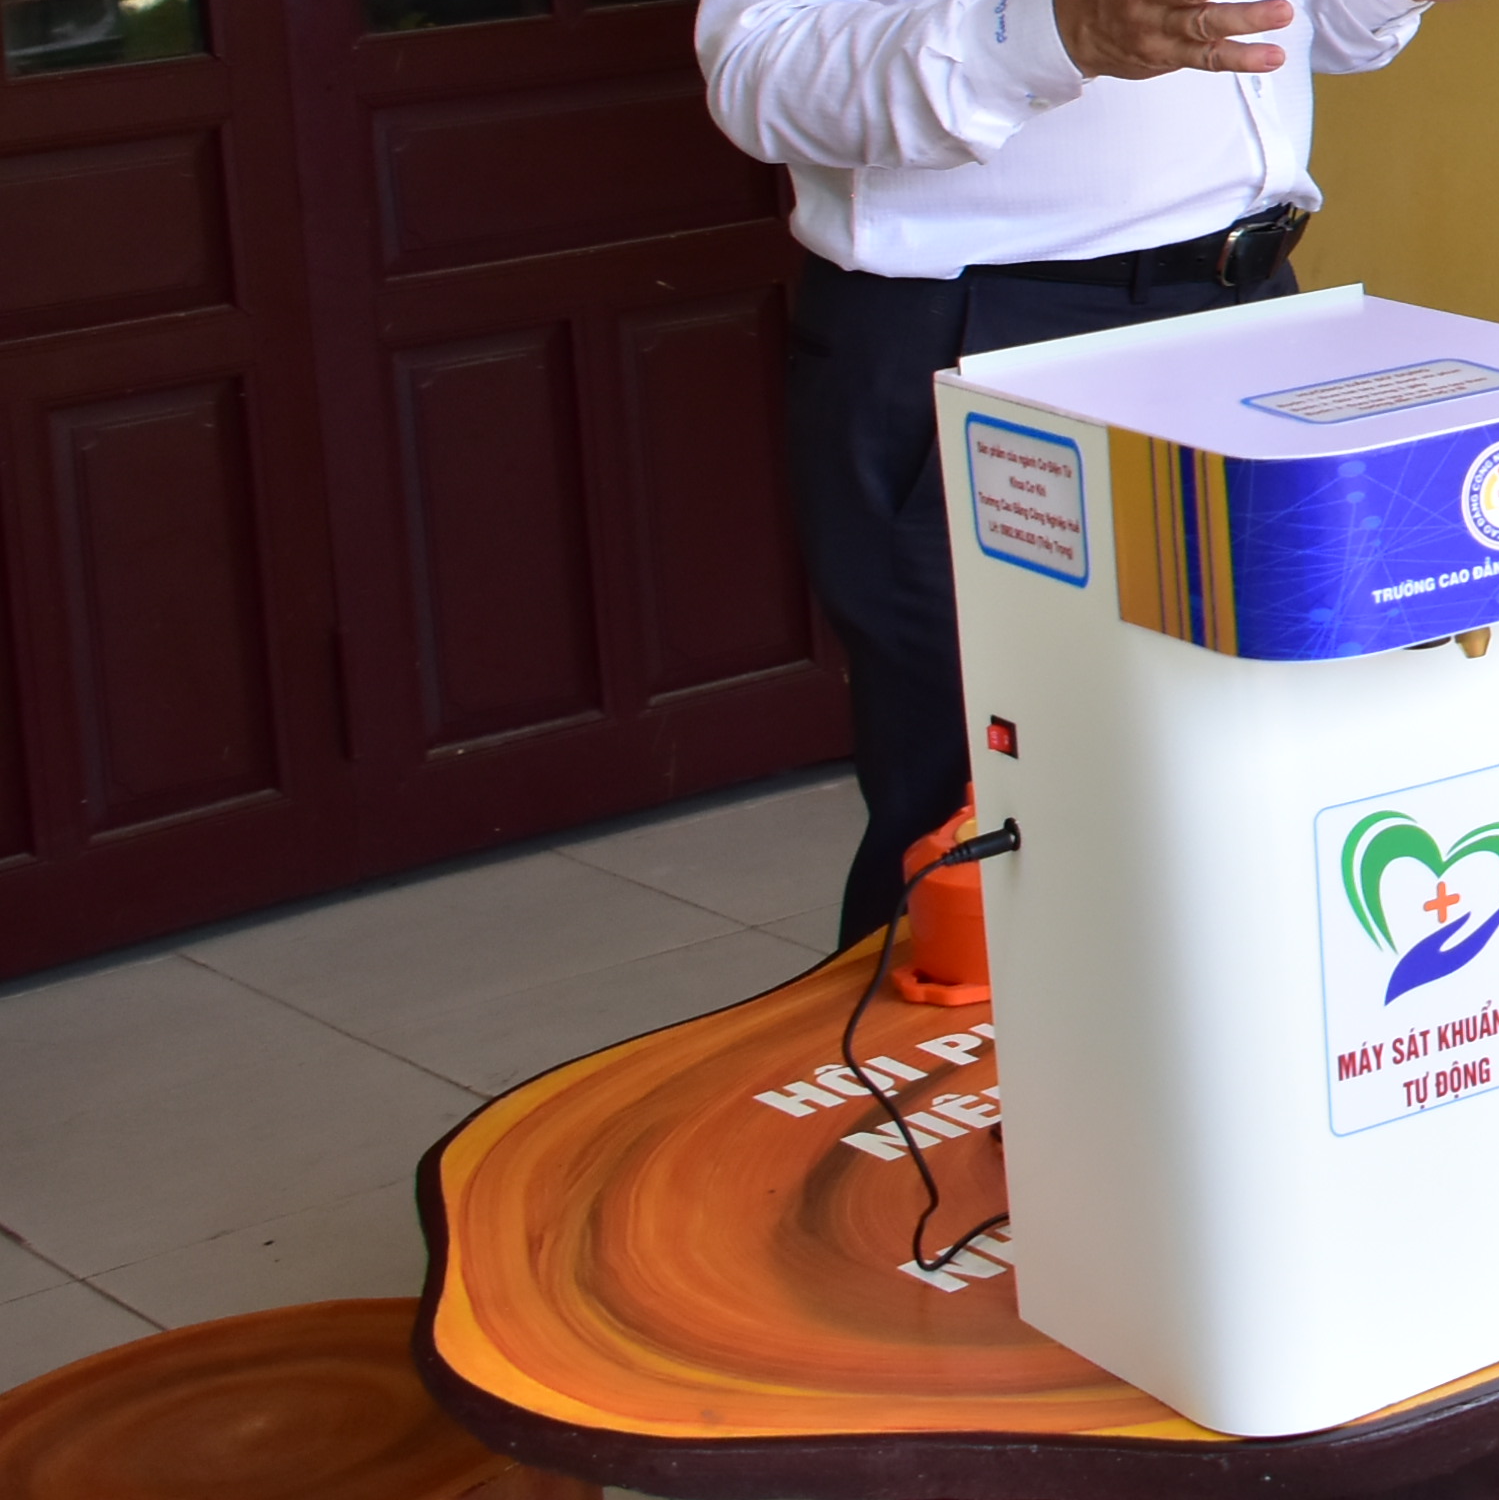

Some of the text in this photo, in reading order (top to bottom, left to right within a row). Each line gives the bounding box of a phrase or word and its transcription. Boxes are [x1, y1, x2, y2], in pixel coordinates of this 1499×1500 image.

[1372, 579, 1436, 604] TRƯỜNG
[1439, 569, 1470, 588] CAO
[1337, 1041, 1385, 1082] MÁY
[1391, 1027, 1430, 1066] SÁT
[753, 1056, 929, 1118] HỘI
[1403, 1056, 1491, 1110] TỰ ĐỘNG
[840, 1085, 1002, 1161] NIÊ
